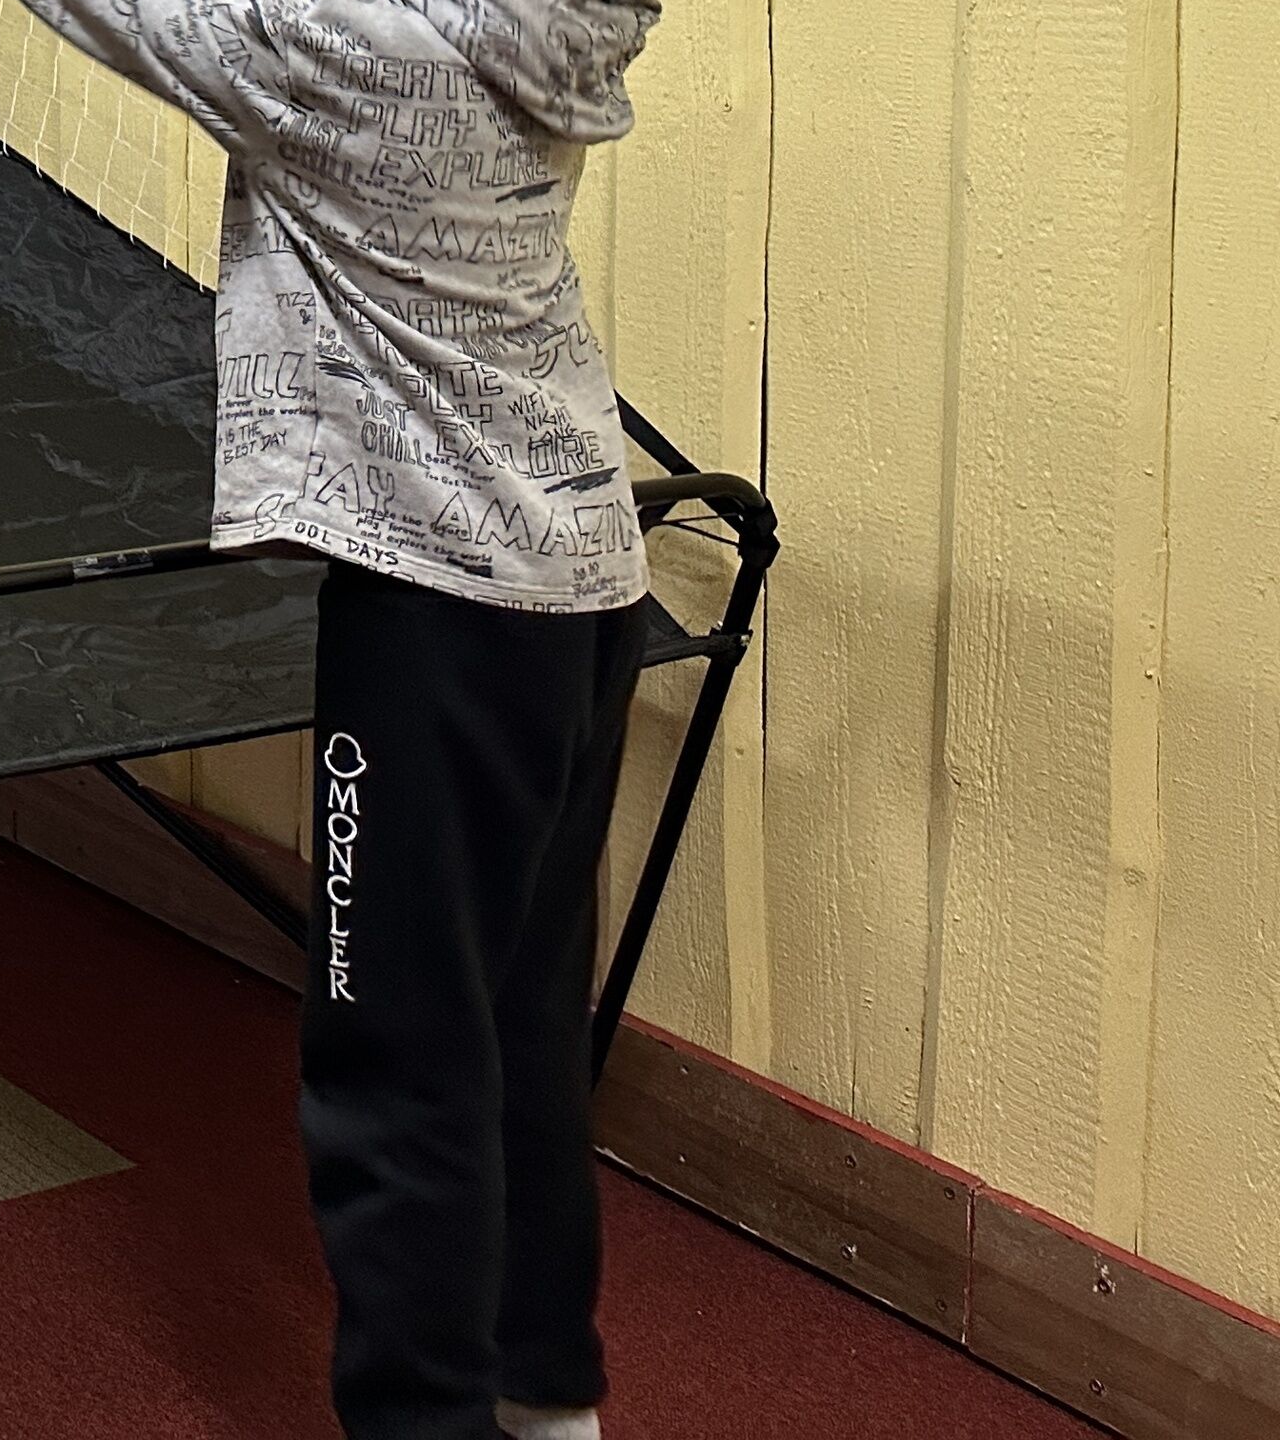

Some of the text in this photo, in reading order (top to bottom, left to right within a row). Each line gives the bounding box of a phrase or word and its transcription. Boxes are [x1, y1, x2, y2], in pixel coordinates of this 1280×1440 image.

[312, 52, 485, 101] CREATE
[348, 97, 476, 148] PLAY
[370, 143, 548, 189] EXPLORE
[258, 407, 276, 417] the
[507, 391, 546, 416] WIFI
[239, 419, 265, 440] THE
[222, 428, 288, 466] BEST DAY
[361, 420, 431, 470] CHILL
[355, 516, 427, 540] play forever
[402, 514, 423, 527] the
[346, 538, 400, 566] DAYS
[360, 529, 382, 541] and
[386, 534, 428, 553] explore
[326, 777, 361, 1002] MONCLER
